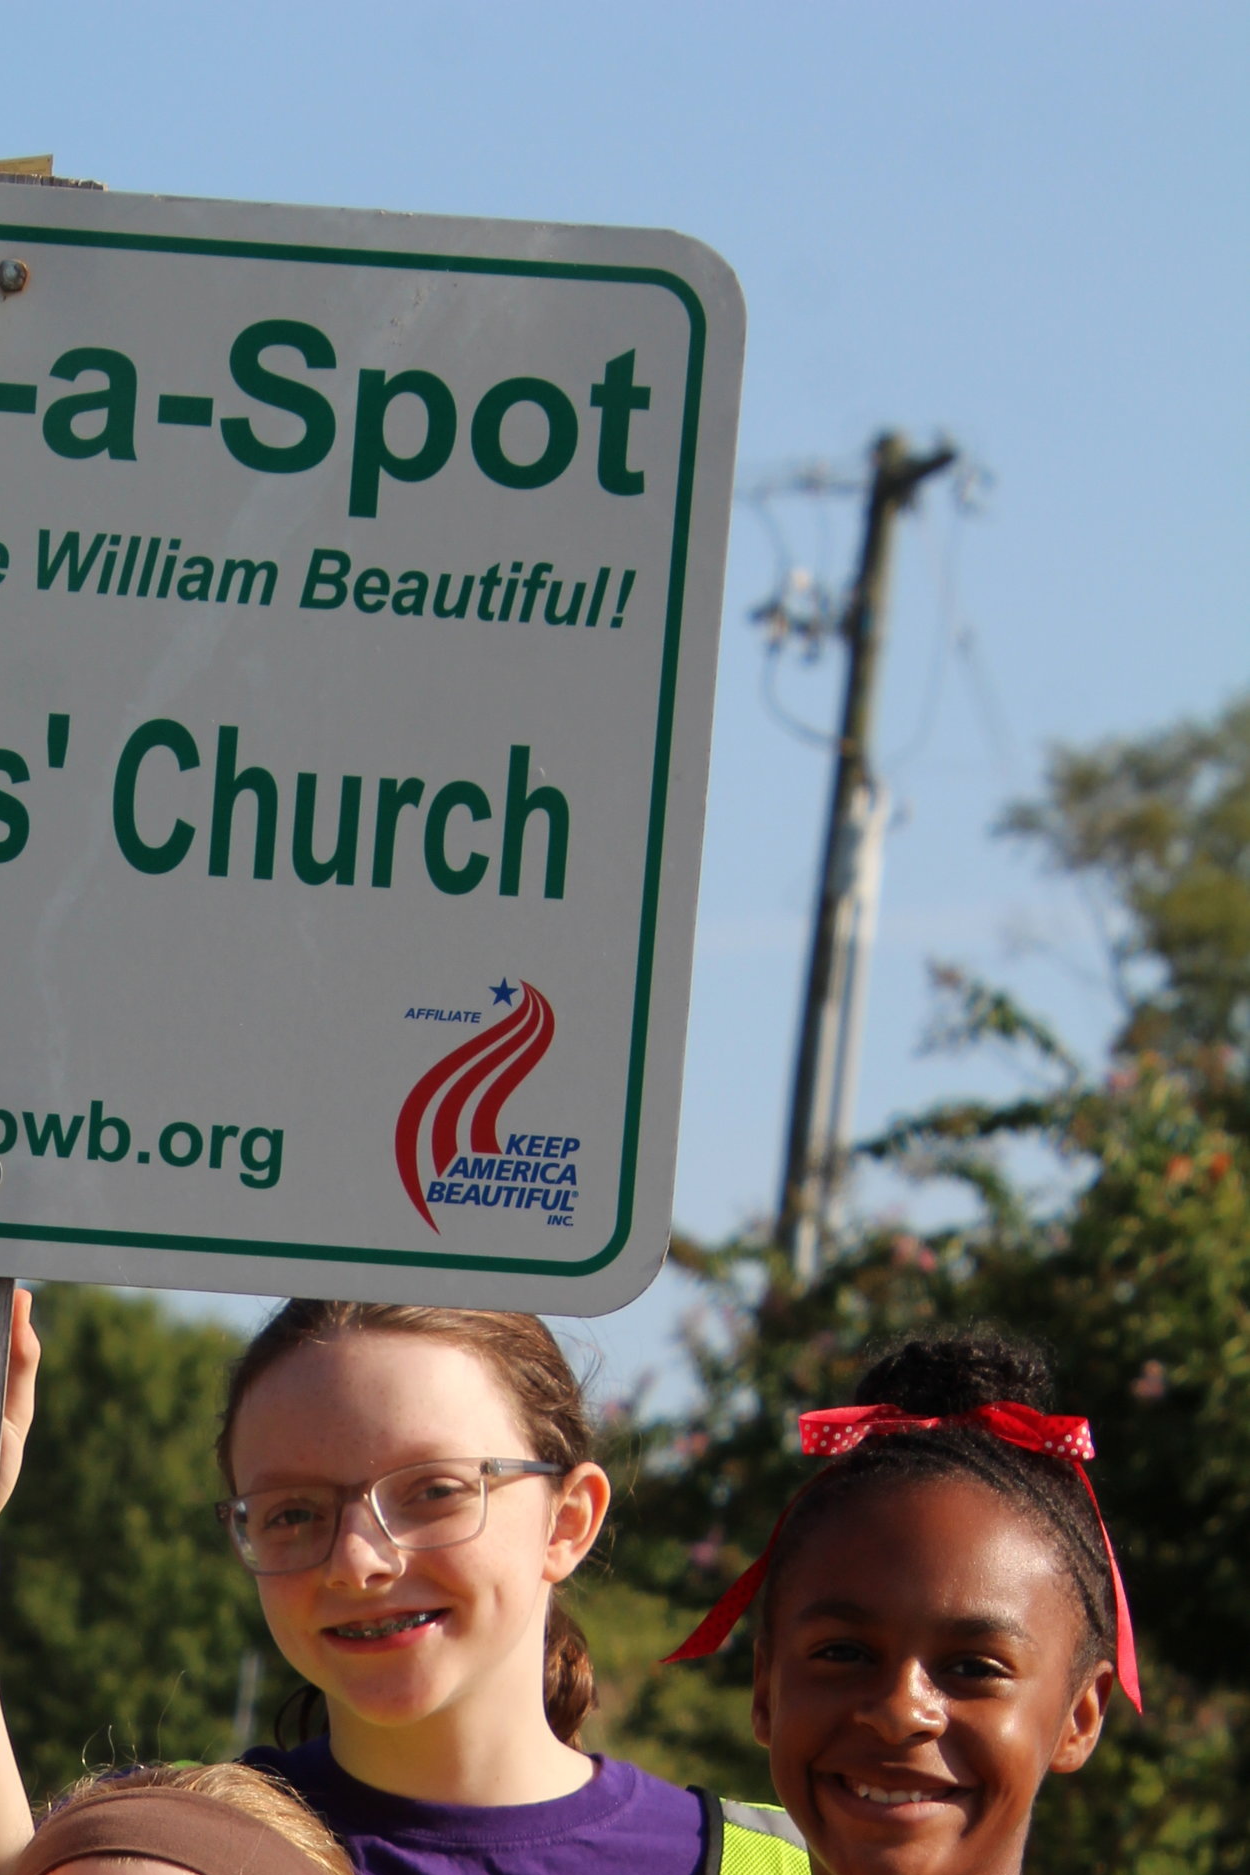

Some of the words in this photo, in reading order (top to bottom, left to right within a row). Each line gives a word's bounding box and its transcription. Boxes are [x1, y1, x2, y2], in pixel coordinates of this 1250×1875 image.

[36, 528, 279, 607] William
[298, 548, 637, 629] Beautiful!
[112, 718, 570, 900] Church
[404, 1007, 482, 1024] AFFILIATE
[505, 1133, 581, 1159] KEEP
[447, 1156, 577, 1186] AMERICA
[547, 1214, 574, 1228] INC.
